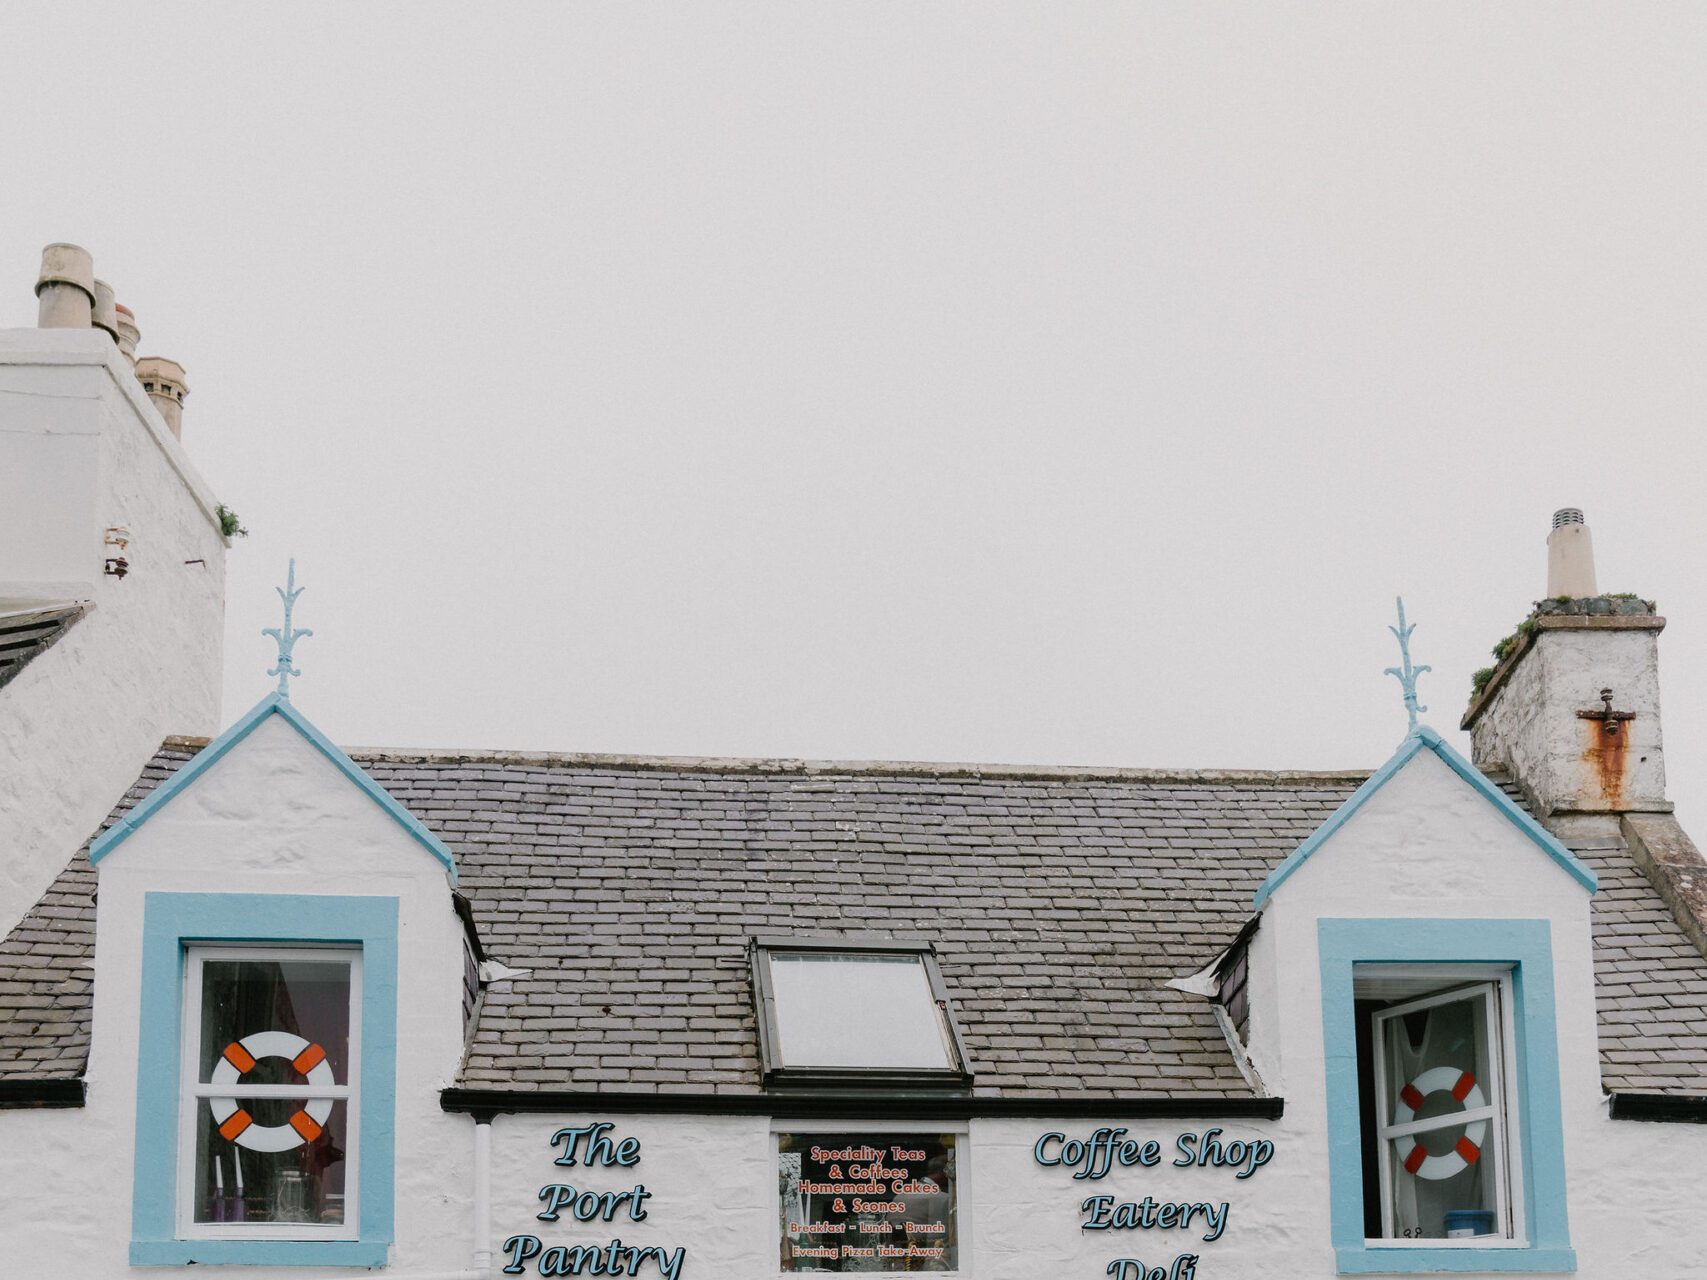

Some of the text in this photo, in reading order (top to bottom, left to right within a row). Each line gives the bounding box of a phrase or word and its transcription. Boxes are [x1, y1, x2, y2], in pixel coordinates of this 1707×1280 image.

[550, 1122, 641, 1167] The
[811, 1145, 926, 1164] Speciality Teas
[1034, 1128, 1274, 1180] Coffee Shop
[828, 1163, 908, 1179] & Coffees
[798, 1178, 940, 1194] Homemade Cakes
[536, 1183, 652, 1222] Port
[832, 1198, 906, 1213] & Scones
[790, 1220, 846, 1234] Breakfast
[860, 1220, 892, 1234] Lunch
[905, 1220, 945, 1234] Brunch
[1081, 1195, 1230, 1242] Eatery
[792, 1246, 839, 1261] Evening
[842, 1246, 874, 1257] Pizza
